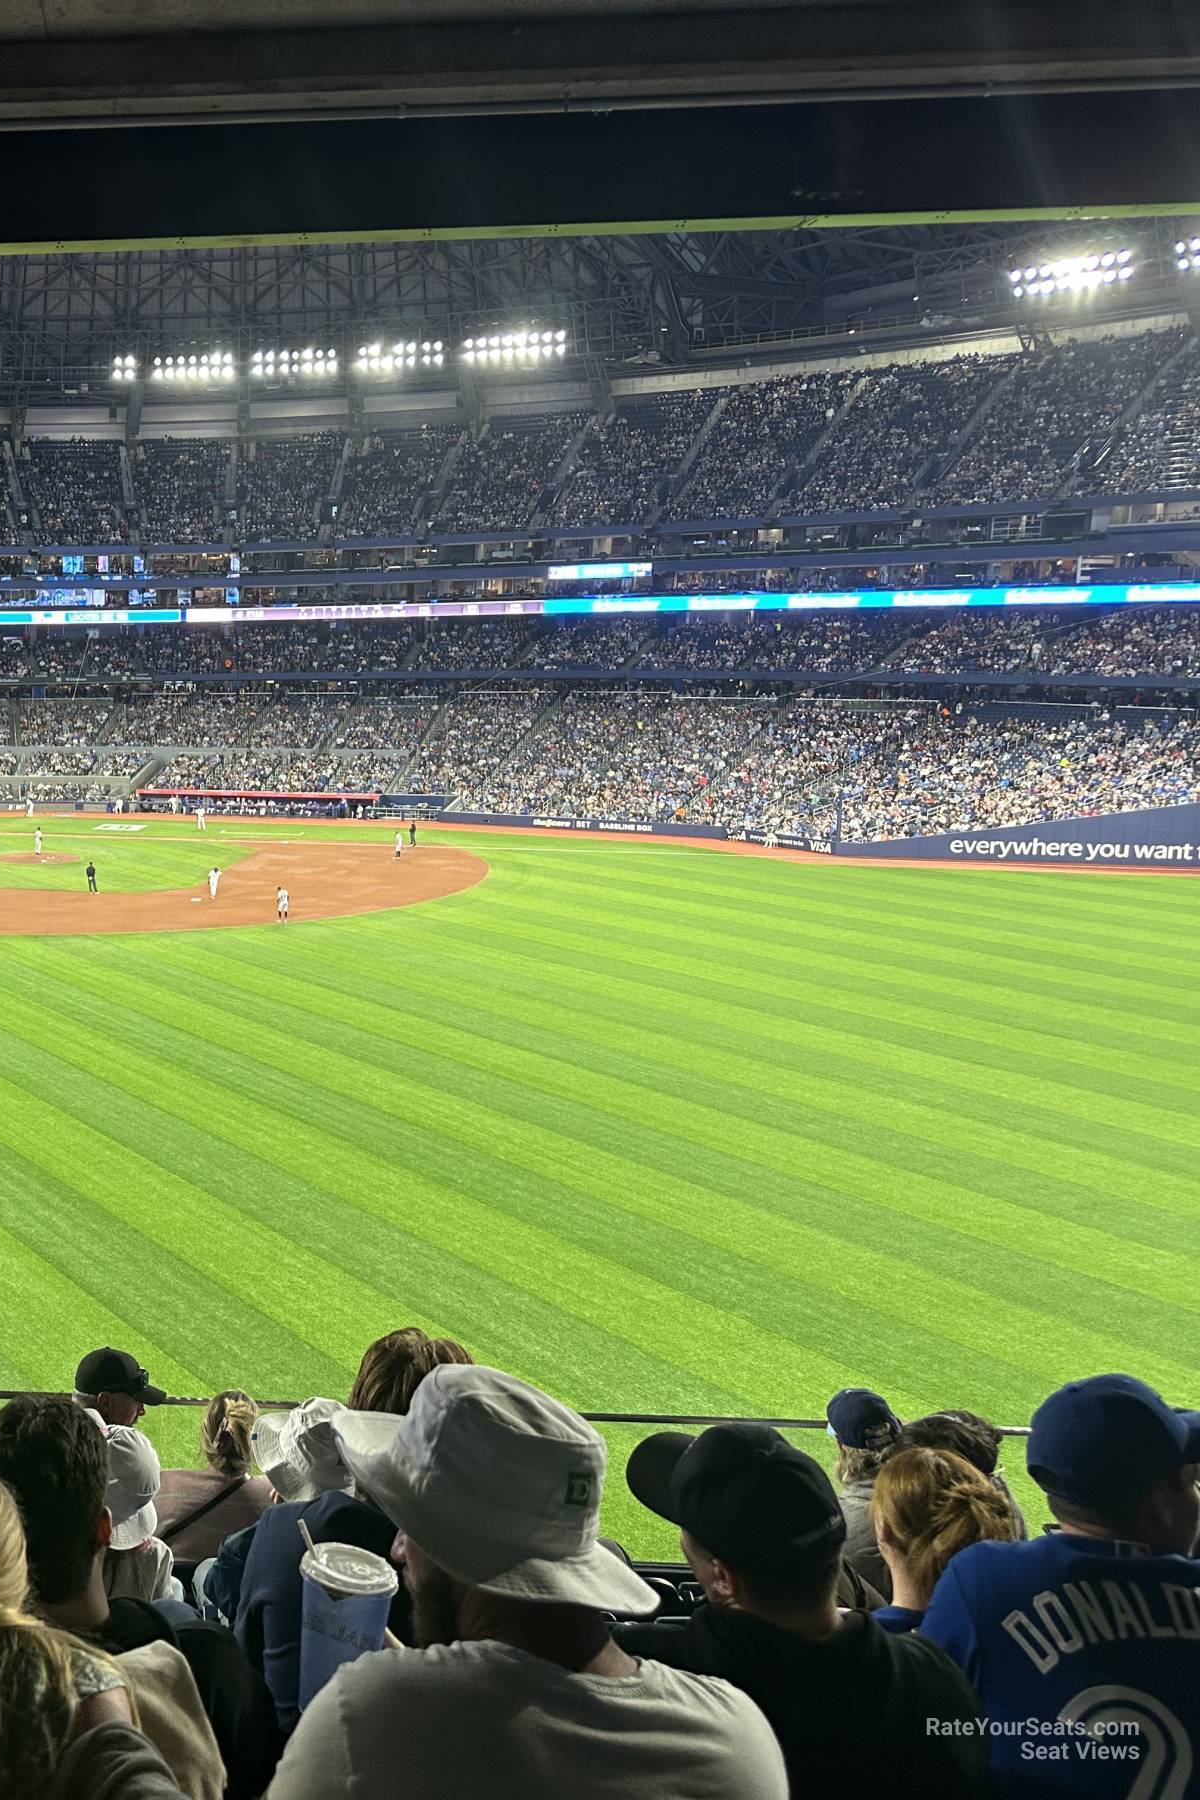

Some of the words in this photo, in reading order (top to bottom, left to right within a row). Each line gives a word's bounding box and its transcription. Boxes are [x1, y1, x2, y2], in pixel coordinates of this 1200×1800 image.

[576, 820, 592, 829] BET
[599, 822, 636, 831] BASELINE
[636, 824, 653, 832] BOX
[808, 840, 832, 854] VISA
[949, 838, 1083, 859] everywhere
[1084, 842, 1129, 861] you
[1133, 843, 1194, 860] want
